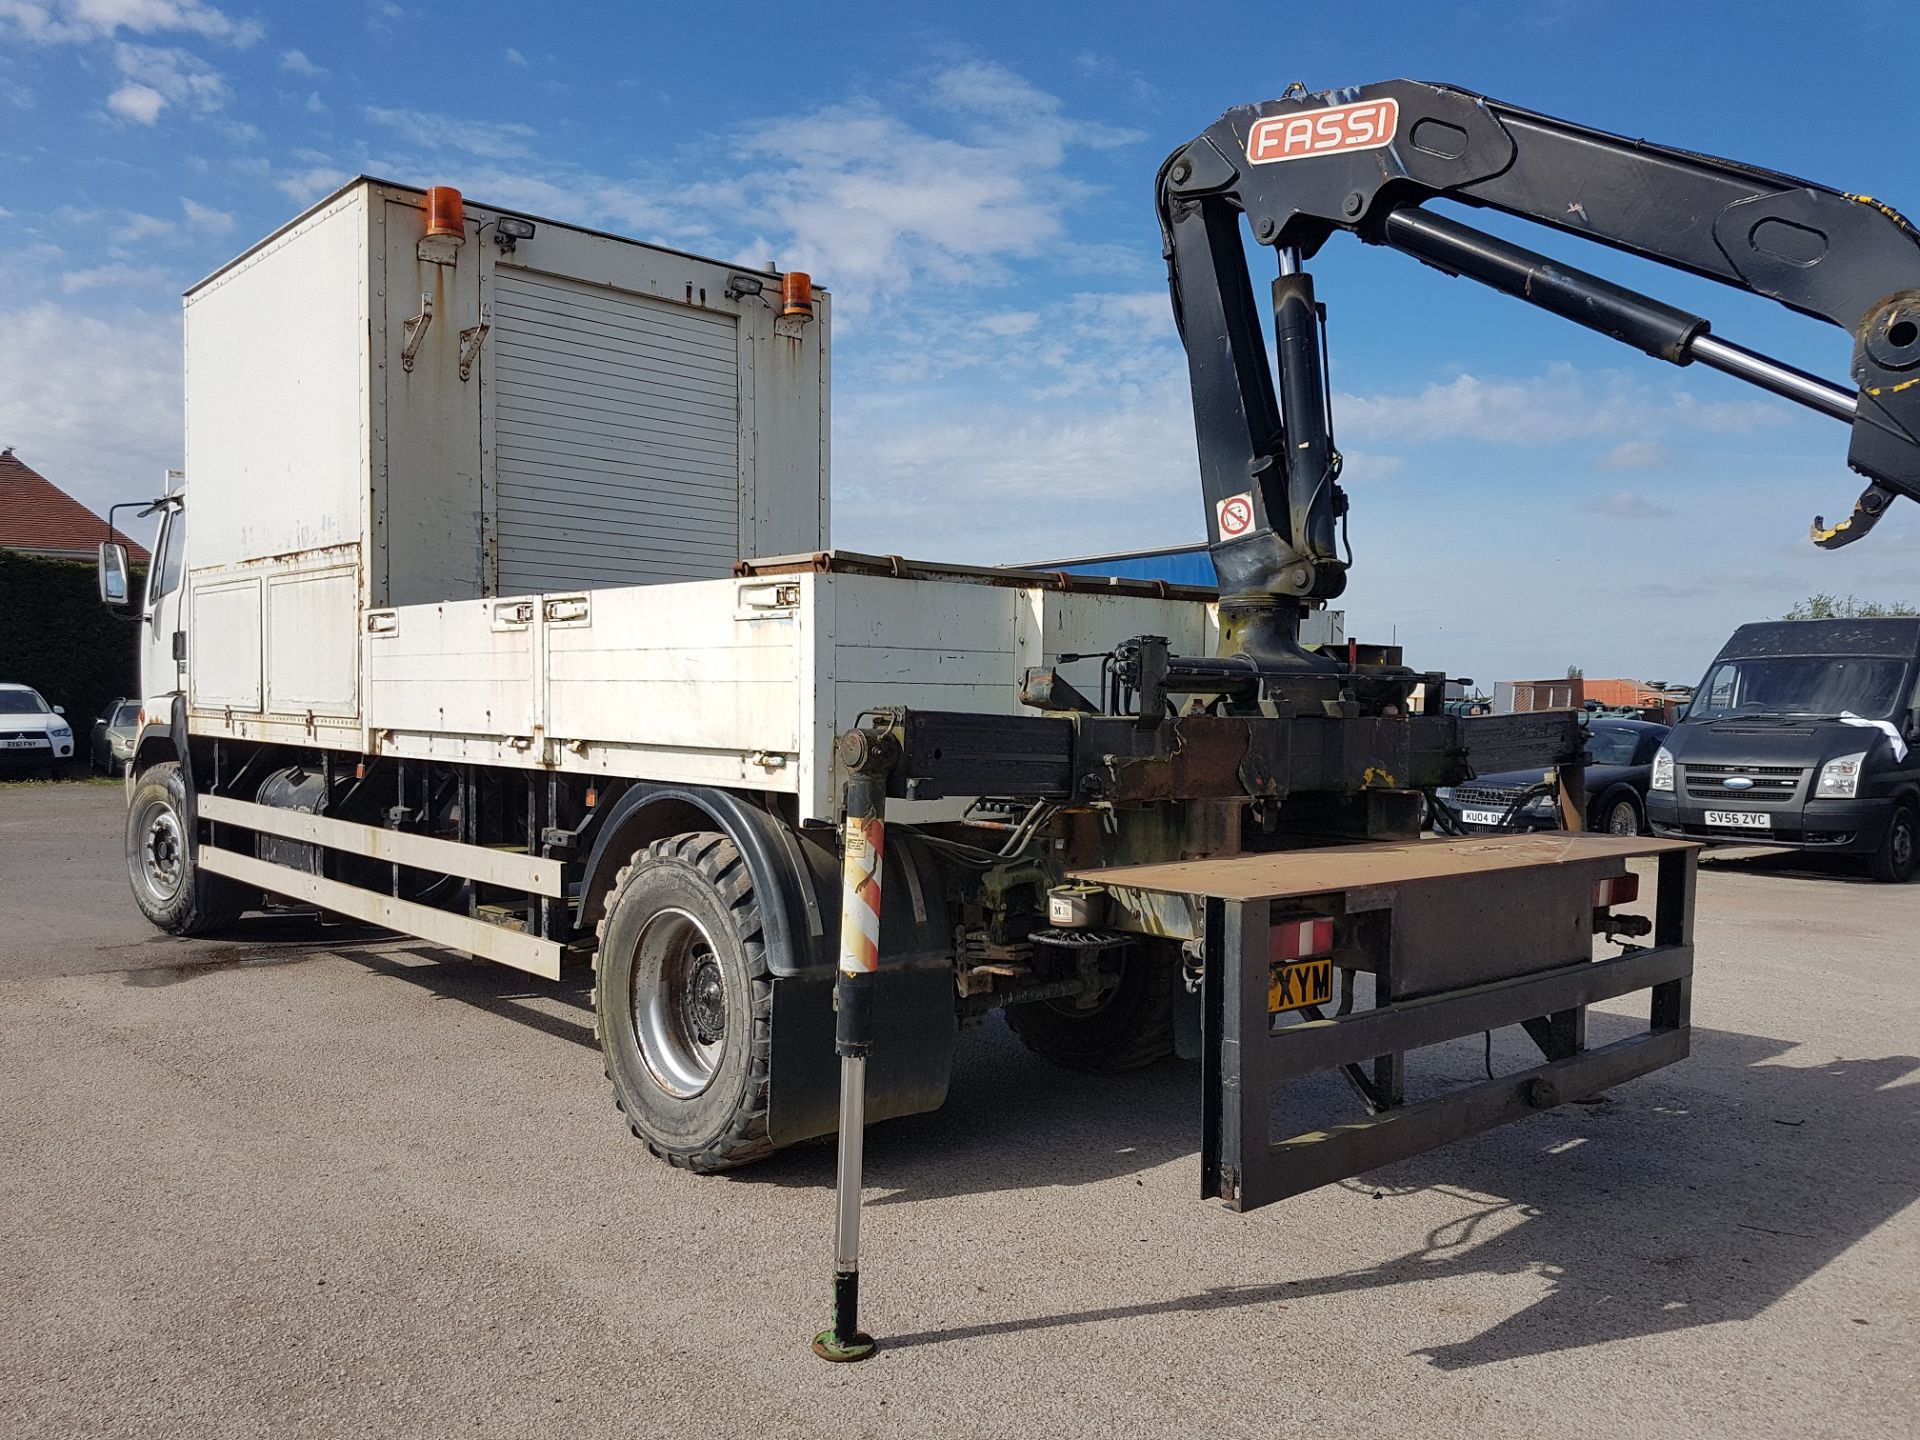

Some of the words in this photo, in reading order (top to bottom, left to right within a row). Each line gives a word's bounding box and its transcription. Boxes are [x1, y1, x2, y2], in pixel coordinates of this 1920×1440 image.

[1257, 106, 1387, 158] FASSI
[1466, 812, 1489, 822] KU04
[1709, 812, 1739, 824] SV56
[1742, 813, 1766, 825] ZVC
[1276, 963, 1329, 1008] XYM
